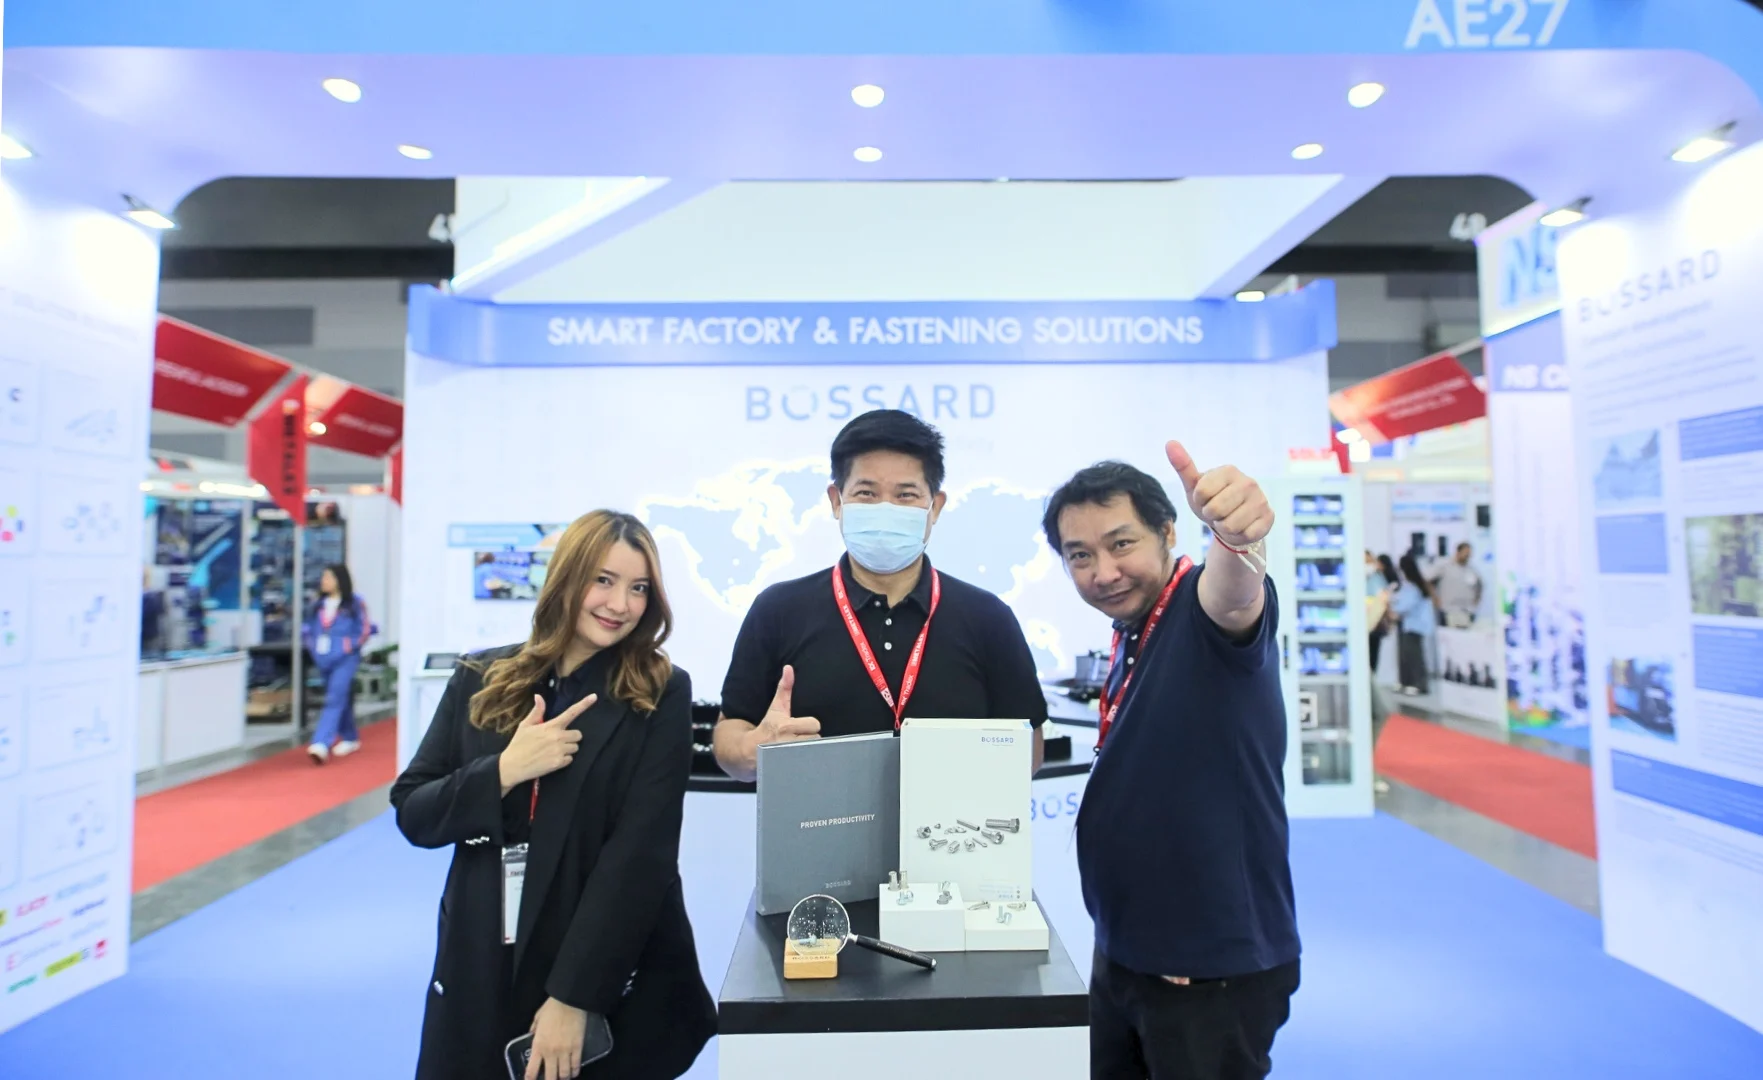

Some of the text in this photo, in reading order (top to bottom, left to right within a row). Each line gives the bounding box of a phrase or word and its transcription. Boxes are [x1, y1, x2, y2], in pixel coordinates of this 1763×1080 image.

[1402, 0, 1570, 49] AE27
[547, 316, 1204, 345] SMART FACTORY & FASTENING SOLUTIONS
[746, 384, 996, 422] BOSSARD
[981, 736, 1014, 744] BOSSARD
[800, 813, 875, 829] PROVEN PRODUCTIVITY
